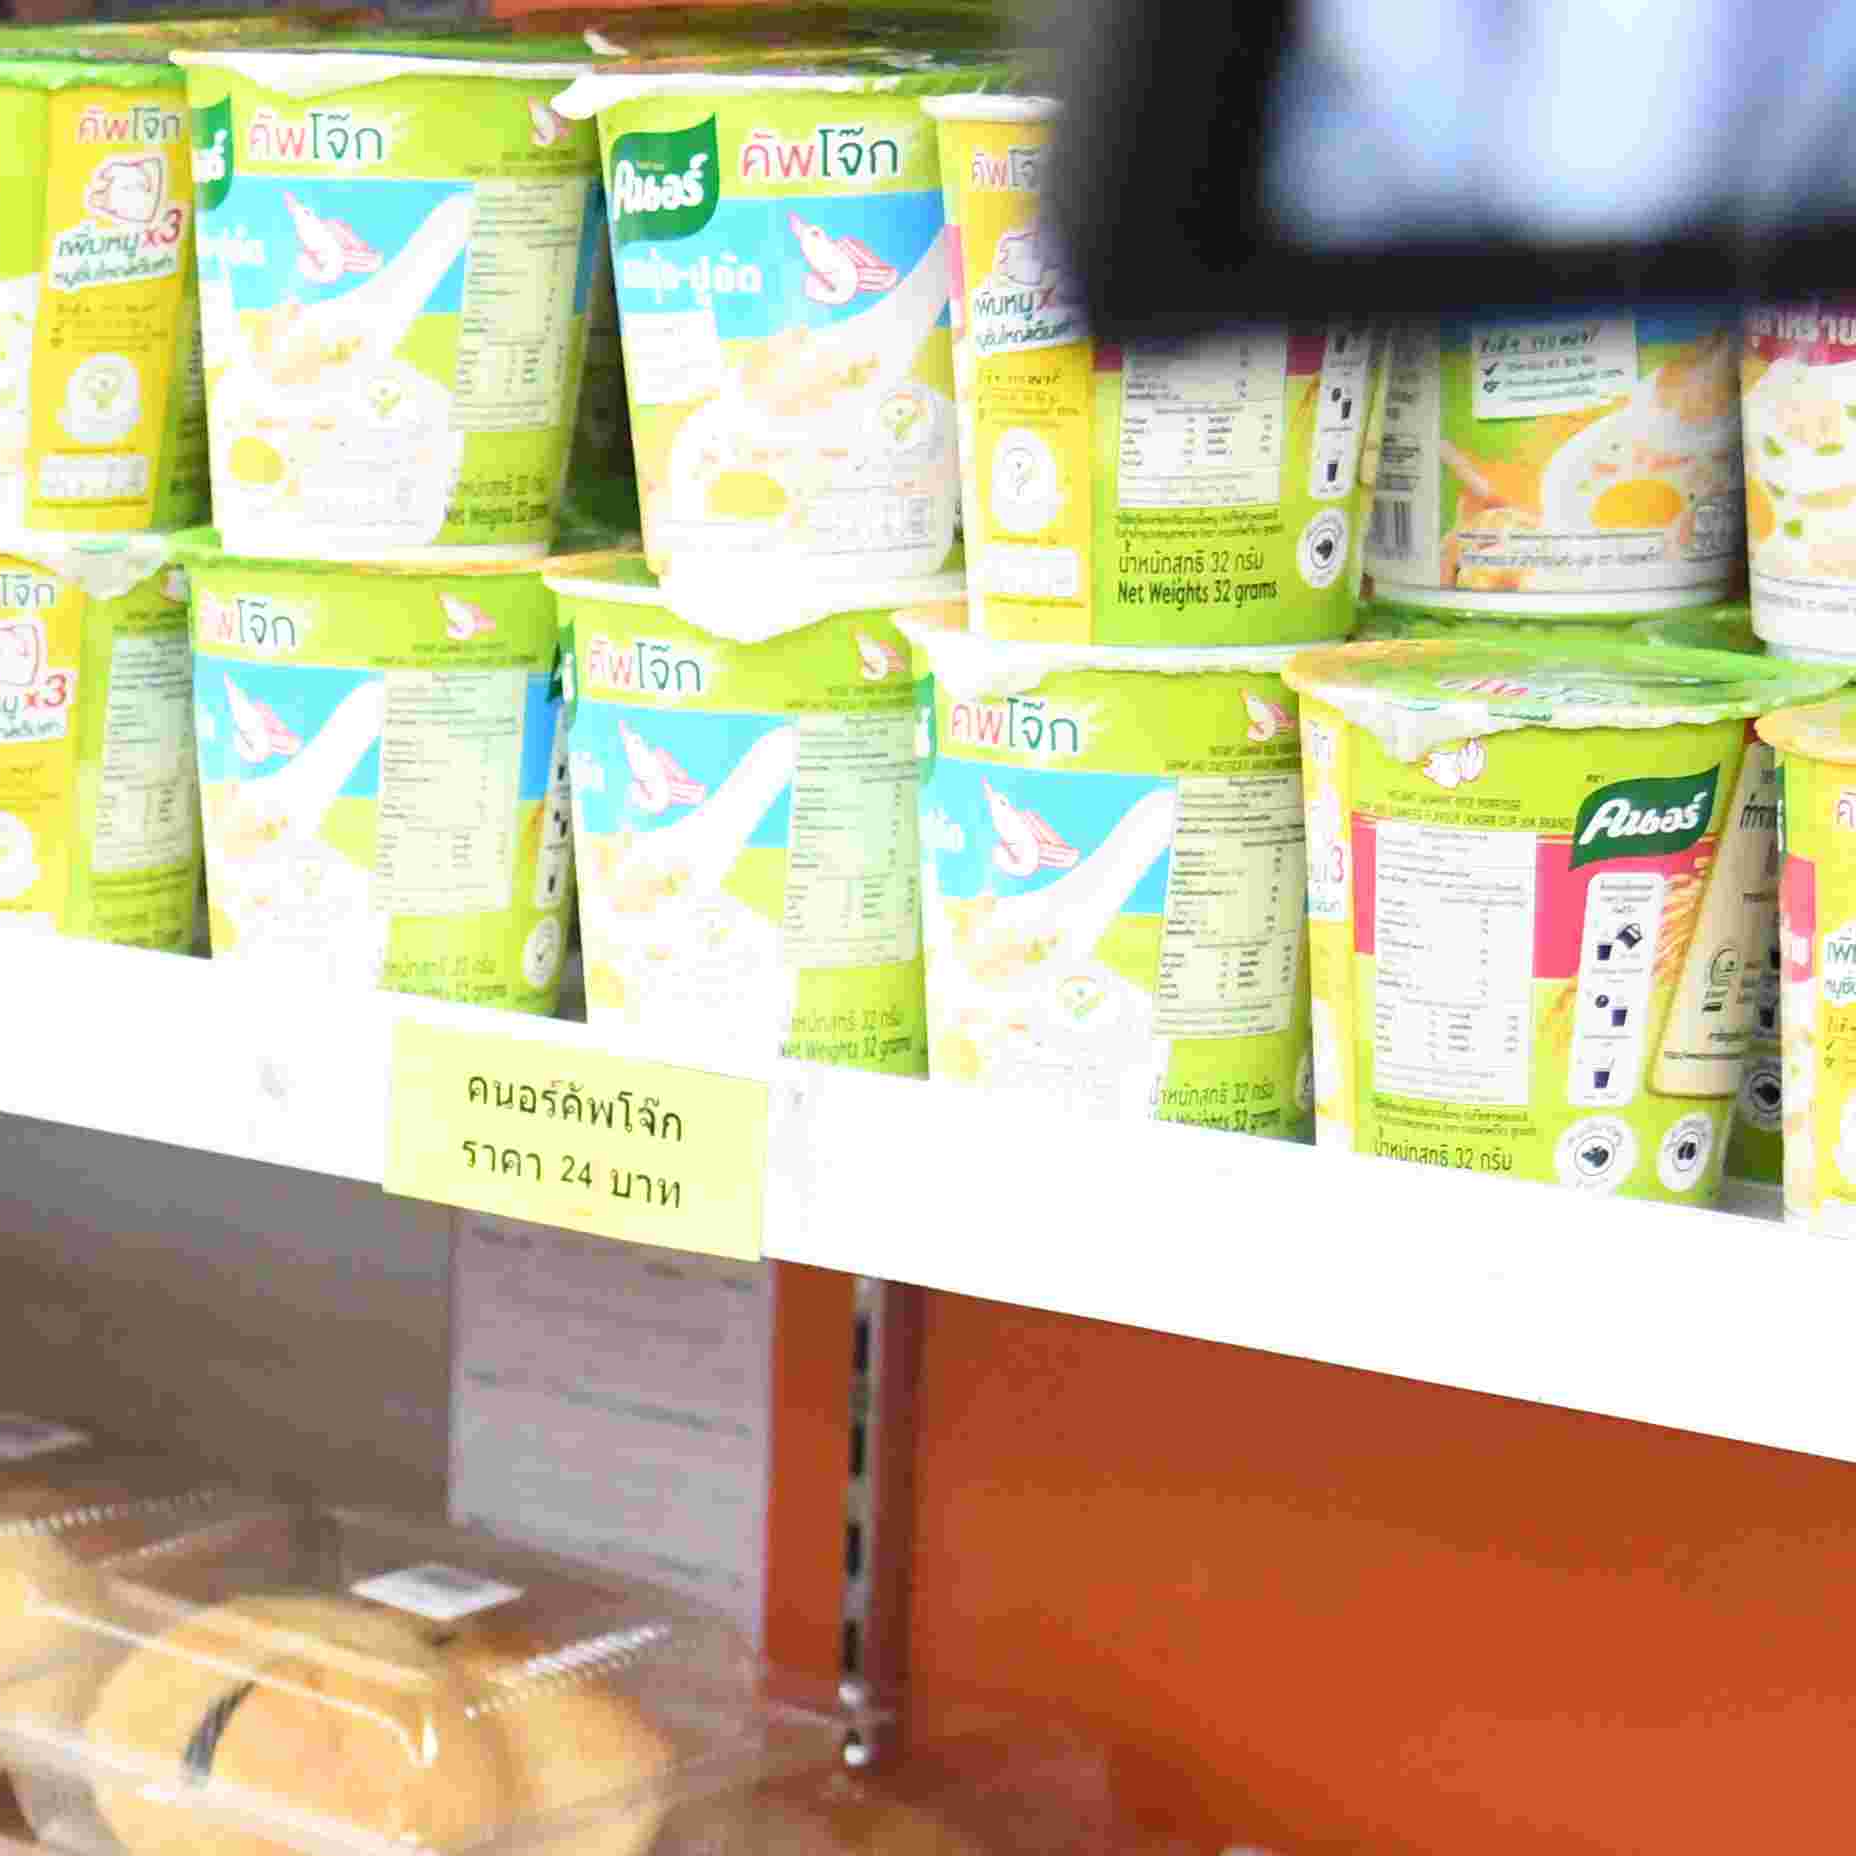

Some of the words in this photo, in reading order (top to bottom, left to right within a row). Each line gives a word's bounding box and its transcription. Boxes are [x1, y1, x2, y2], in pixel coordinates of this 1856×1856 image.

[742, 127, 899, 178] คัพโจ๊ก
[1210, 550, 1230, 574] 32
[1234, 546, 1264, 571] กรัม
[1117, 579, 1142, 604] Net
[1148, 577, 1208, 611] Weights
[1214, 579, 1234, 602] 32
[1234, 577, 1278, 609] grams
[951, 699, 1079, 754] คพโจ๊ก
[1579, 792, 1709, 846] คนอร์
[467, 1073, 684, 1142] คนอร์คัพโจ๊ก
[461, 1137, 542, 1182] ราคา
[558, 1154, 593, 1190] 24
[609, 1166, 683, 1210] บาท
[1455, 1147, 1474, 1171] 32
[1479, 1144, 1513, 1172] กรัม
